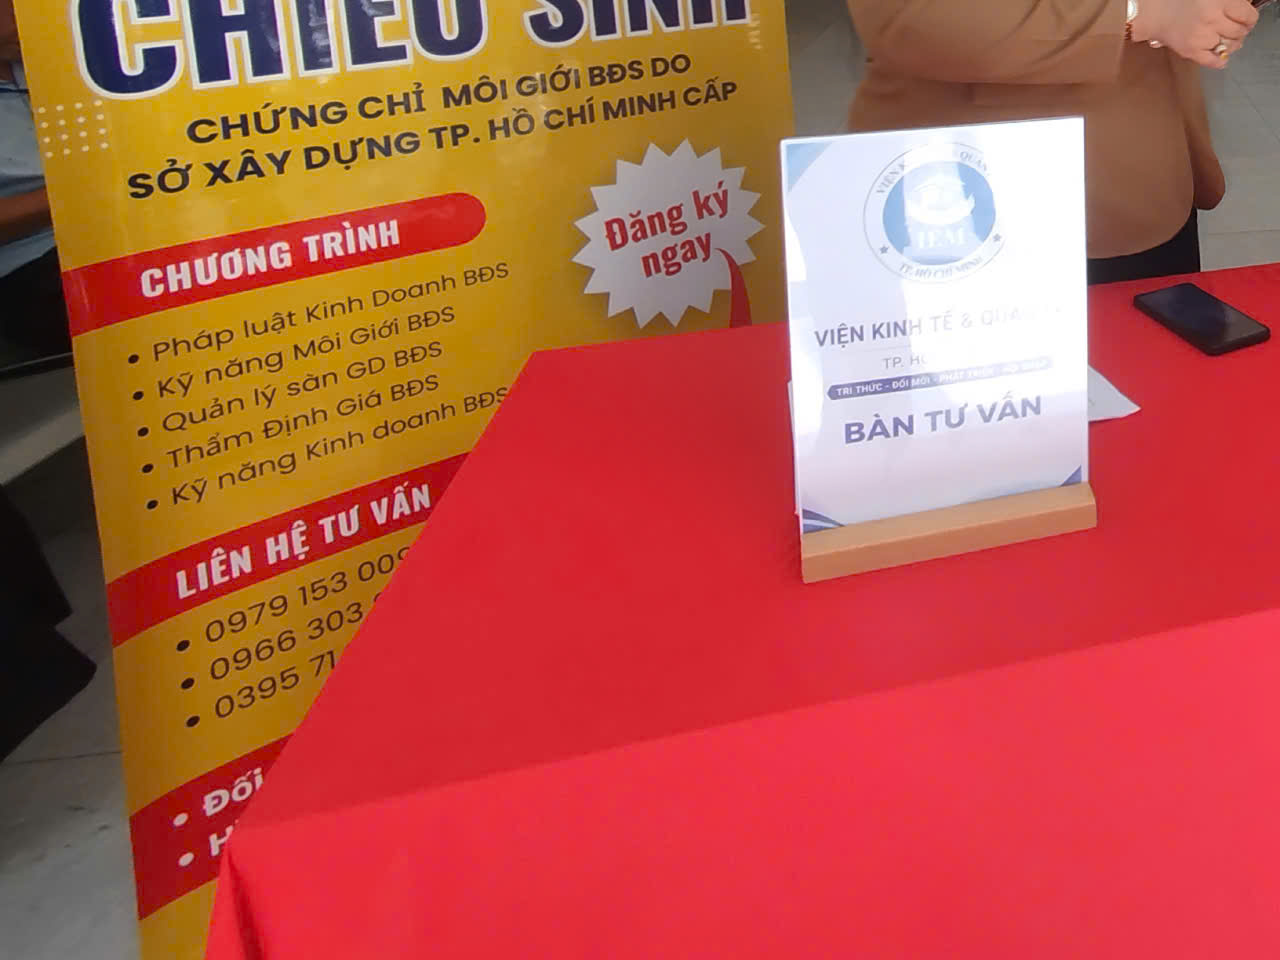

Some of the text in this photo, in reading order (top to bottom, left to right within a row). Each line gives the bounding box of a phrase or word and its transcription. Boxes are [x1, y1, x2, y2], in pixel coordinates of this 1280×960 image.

[186, 53, 692, 144] CHỨNG CHỈ MÔI GIỚI BĐS DO
[127, 76, 737, 200] SỞ XÂY DỰNG TP. HỒ CHÍ MINH CẤP
[604, 180, 729, 252] Đăng ký
[140, 219, 400, 298] CHƯƠNG TRÌNH
[640, 232, 712, 279] ngay
[152, 262, 510, 362] Pháp luật Kinh Doanh BĐS
[814, 323, 865, 349] VIỆN
[872, 319, 922, 340] KINH
[157, 306, 456, 398] Kỹ năng Môi Giới BĐS
[162, 341, 443, 432] Quản lý sàn GD BĐS
[883, 356, 904, 370] TP.
[262, 407, 328, 439] Định
[336, 390, 382, 417] Giá
[391, 374, 440, 402] BĐS
[845, 390, 1042, 445] BÀN TƯ VẤN
[171, 386, 508, 506] Kỹ năng Kinh doanh BĐS
[176, 481, 432, 600] LIÊN HỆ TƯ VẤN
[205, 595, 289, 643] 0979
[298, 571, 348, 606] 153
[210, 602, 364, 681] 0966 303
[214, 650, 337, 719] 0395 71
[202, 767, 264, 817] Đối
